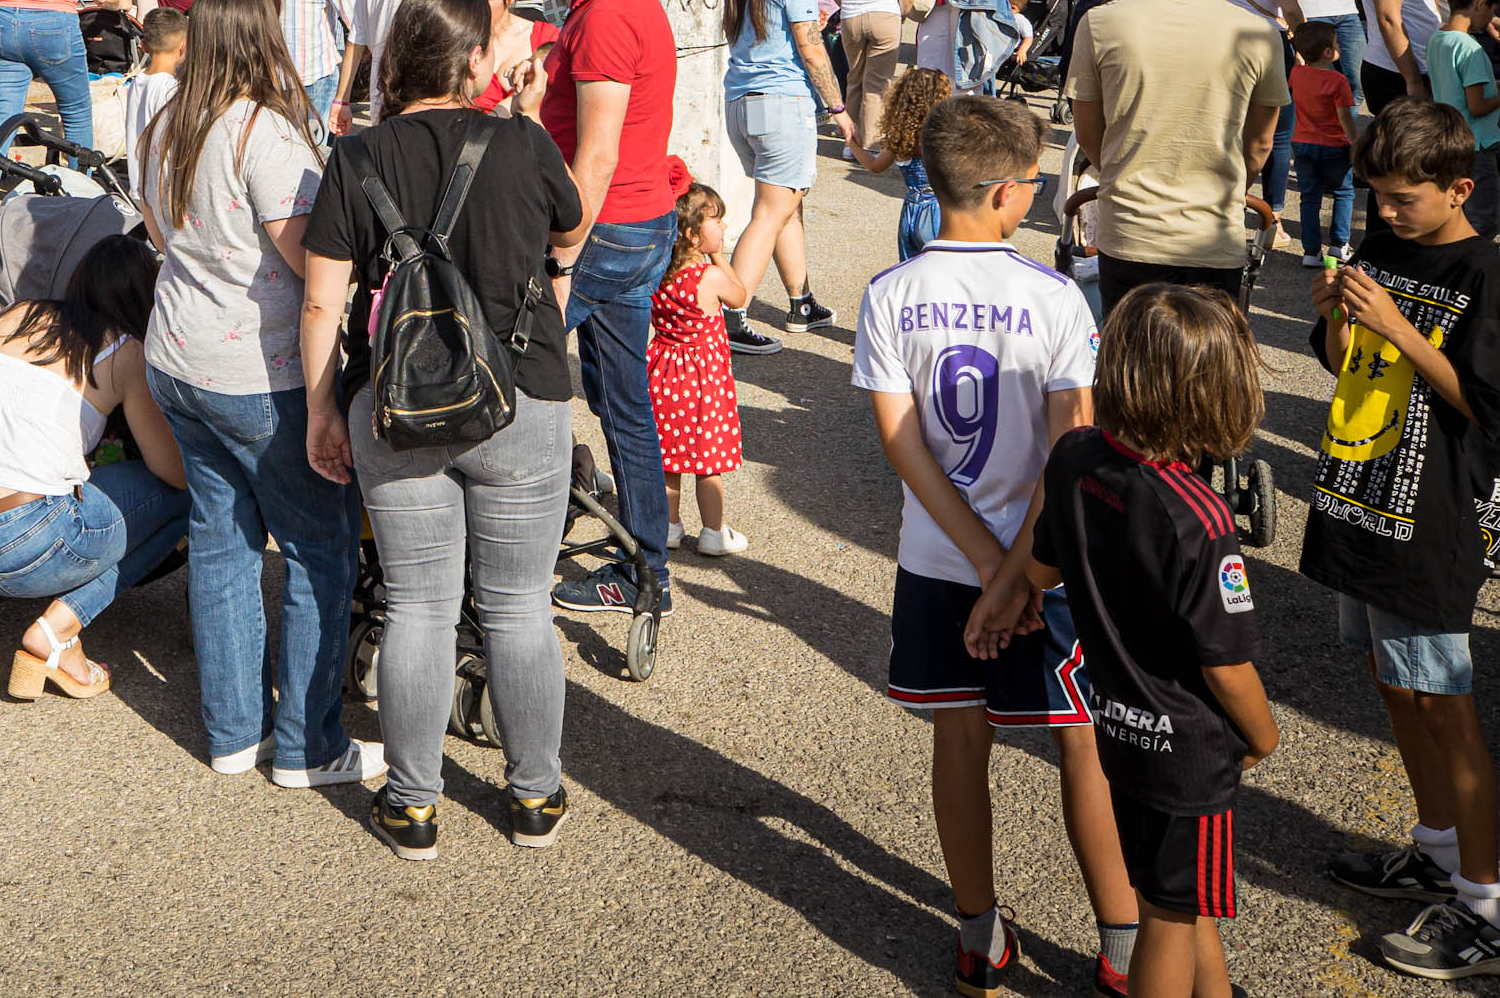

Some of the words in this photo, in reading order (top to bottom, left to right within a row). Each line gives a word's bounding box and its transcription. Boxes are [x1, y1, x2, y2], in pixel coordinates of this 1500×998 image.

[901, 302, 1033, 337] BENZEMA
[933, 345, 999, 486] 9
[596, 583, 626, 606] N
[1227, 594, 1252, 605] LaLig
[1102, 721, 1172, 752] NERGÍA
